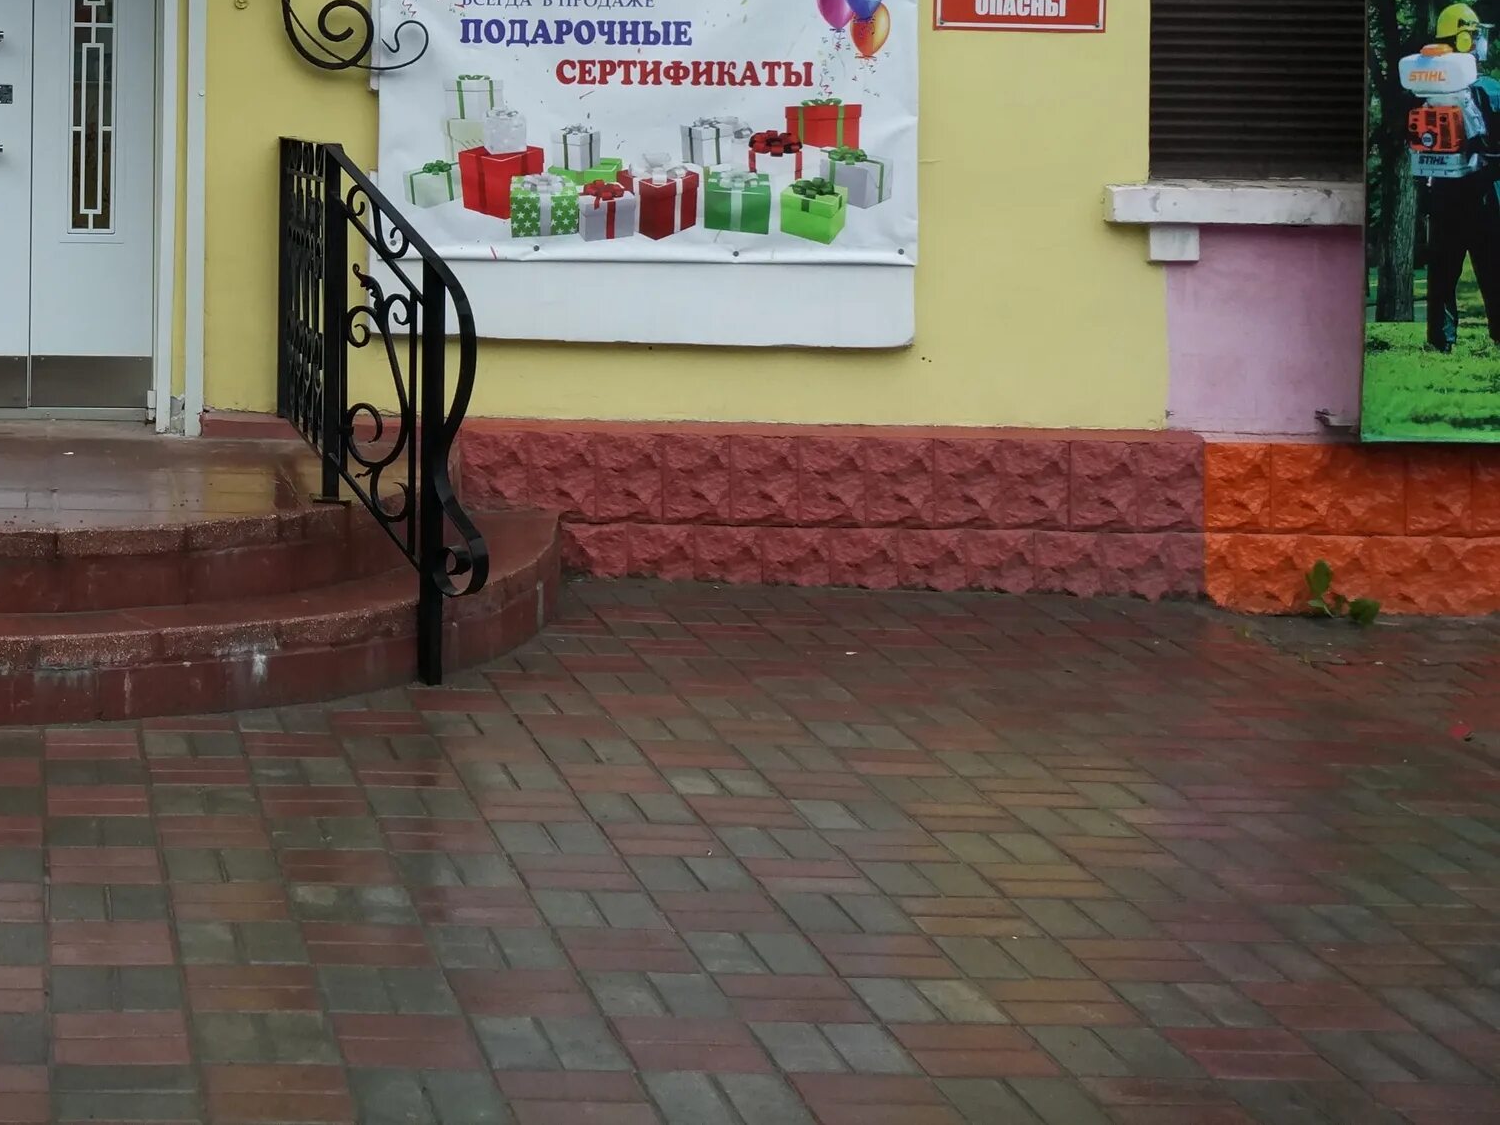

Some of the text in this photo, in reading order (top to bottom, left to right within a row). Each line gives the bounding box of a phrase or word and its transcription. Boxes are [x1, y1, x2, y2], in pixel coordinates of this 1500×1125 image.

[460, 18, 693, 48] ПОДАРОЧНЫЕ
[555, 59, 815, 88] СЕРТИФИКАТЫ
[1409, 70, 1447, 82] STIHL
[1418, 155, 1448, 165] STIHL
